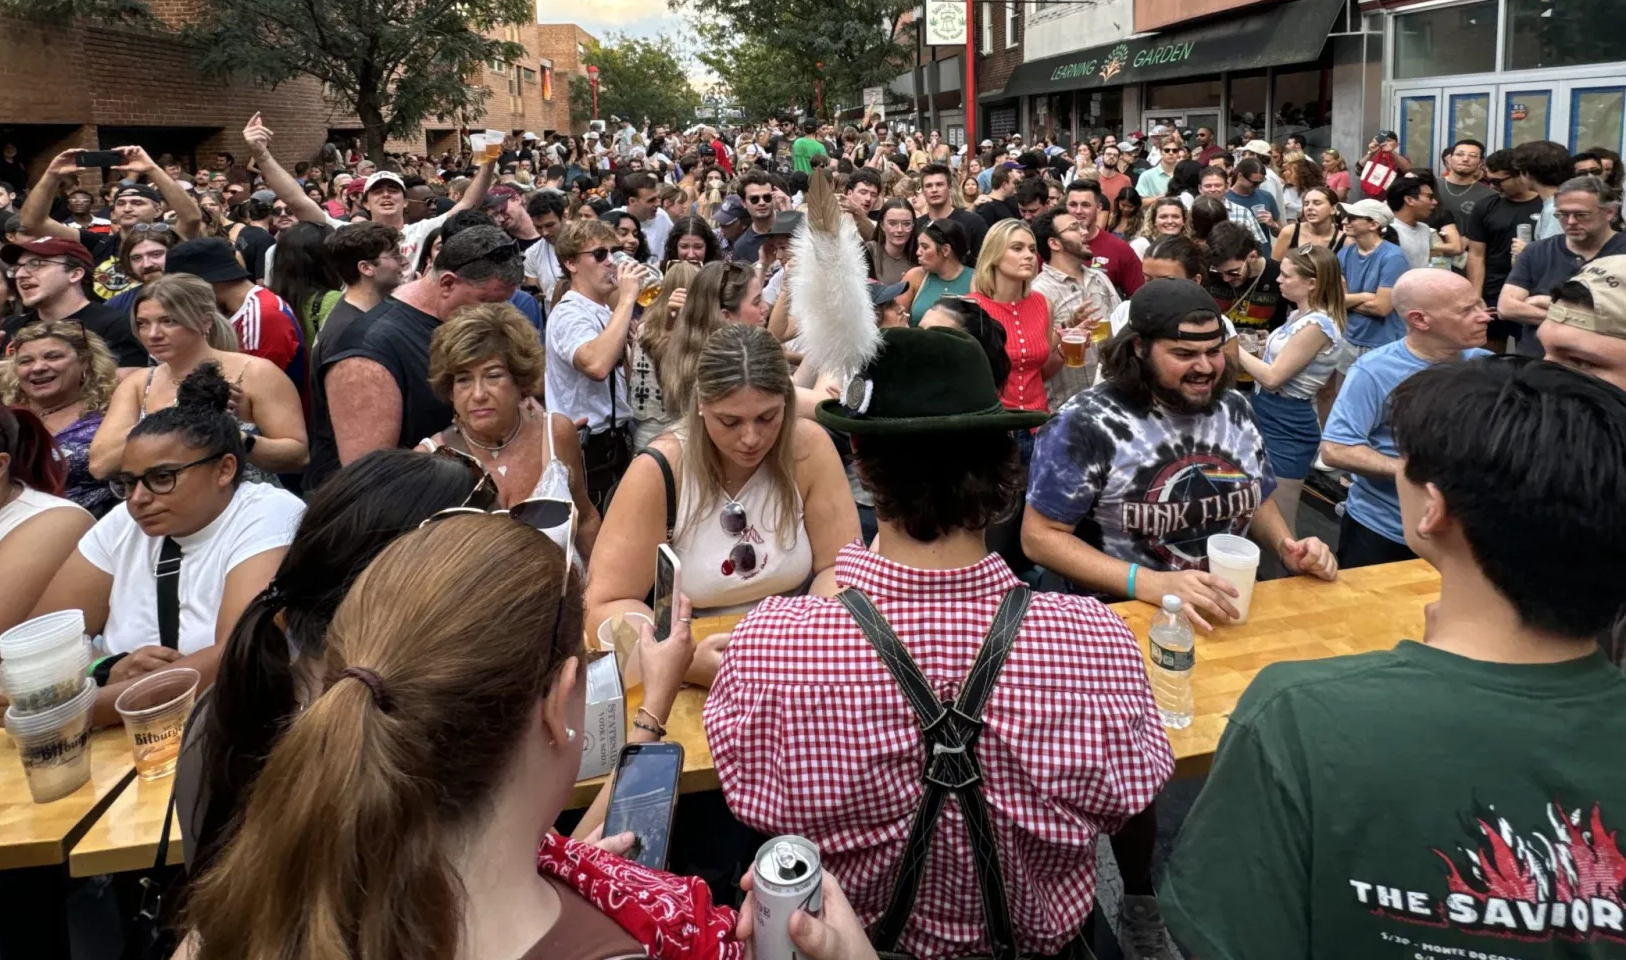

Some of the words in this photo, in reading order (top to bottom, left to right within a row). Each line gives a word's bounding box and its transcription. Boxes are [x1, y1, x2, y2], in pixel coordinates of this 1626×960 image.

[1050, 59, 1097, 80] LEARNING
[1133, 41, 1194, 67] GARDEN
[1122, 501, 1190, 540] PINK
[134, 722, 185, 746] Bitburge
[598, 711, 606, 742] VODKA
[1349, 879, 1432, 915] THE
[1447, 893, 1625, 933] SAVIOR
[1421, 942, 1467, 957] MONTE
